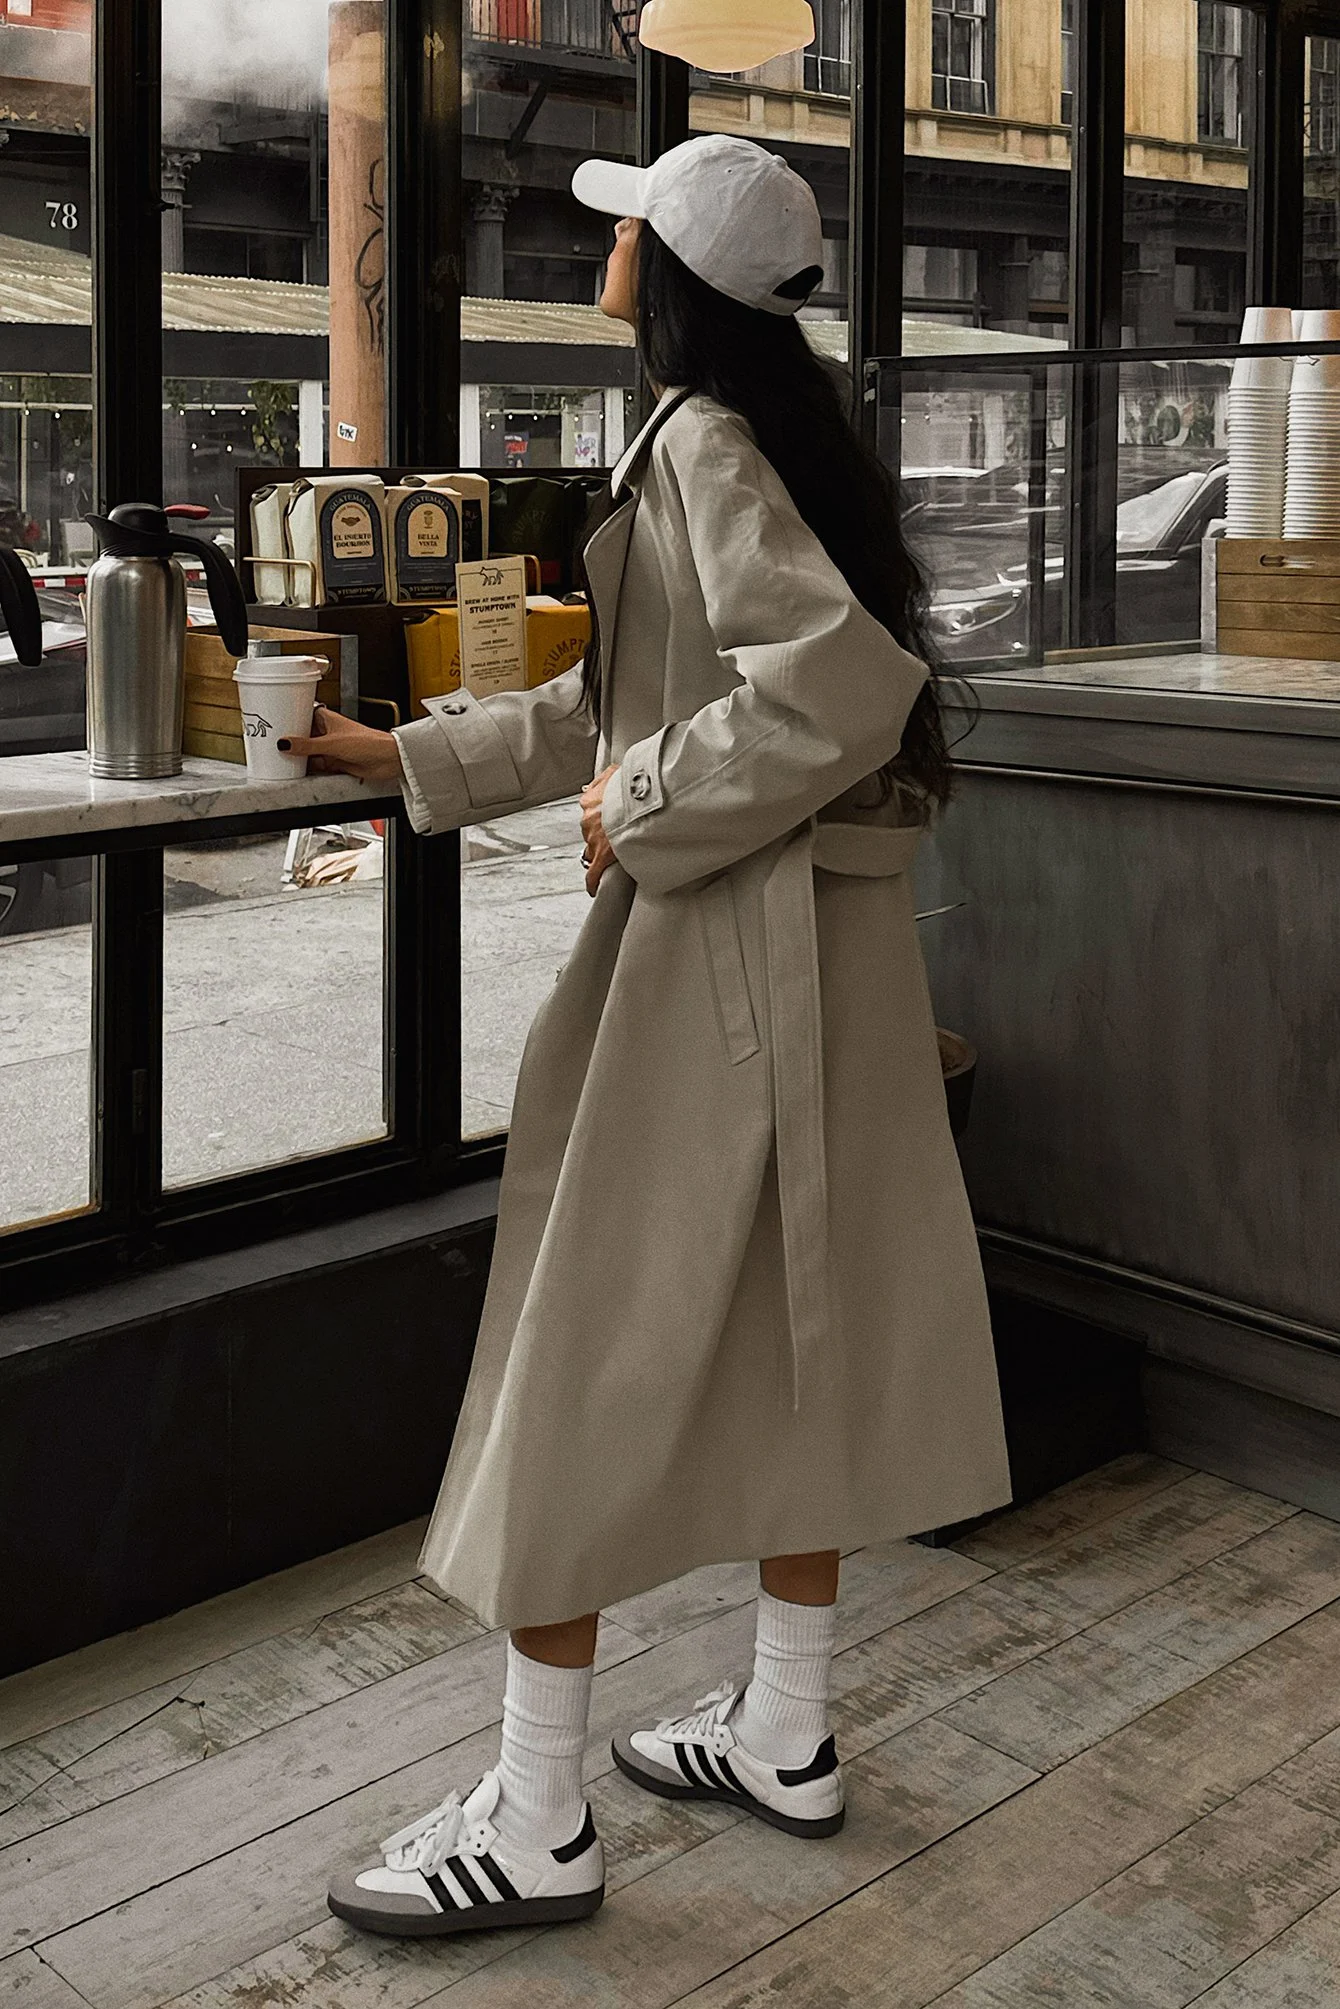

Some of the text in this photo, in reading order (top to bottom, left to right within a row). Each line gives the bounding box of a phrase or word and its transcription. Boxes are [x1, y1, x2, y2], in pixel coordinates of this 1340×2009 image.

[45, 201, 78, 230] 78
[329, 494, 371, 511] GUATEMALA
[406, 496, 450, 511] GUATEMALA
[469, 602, 516, 614] STUMPTOWN
[542, 638, 585, 678] STUMPT
